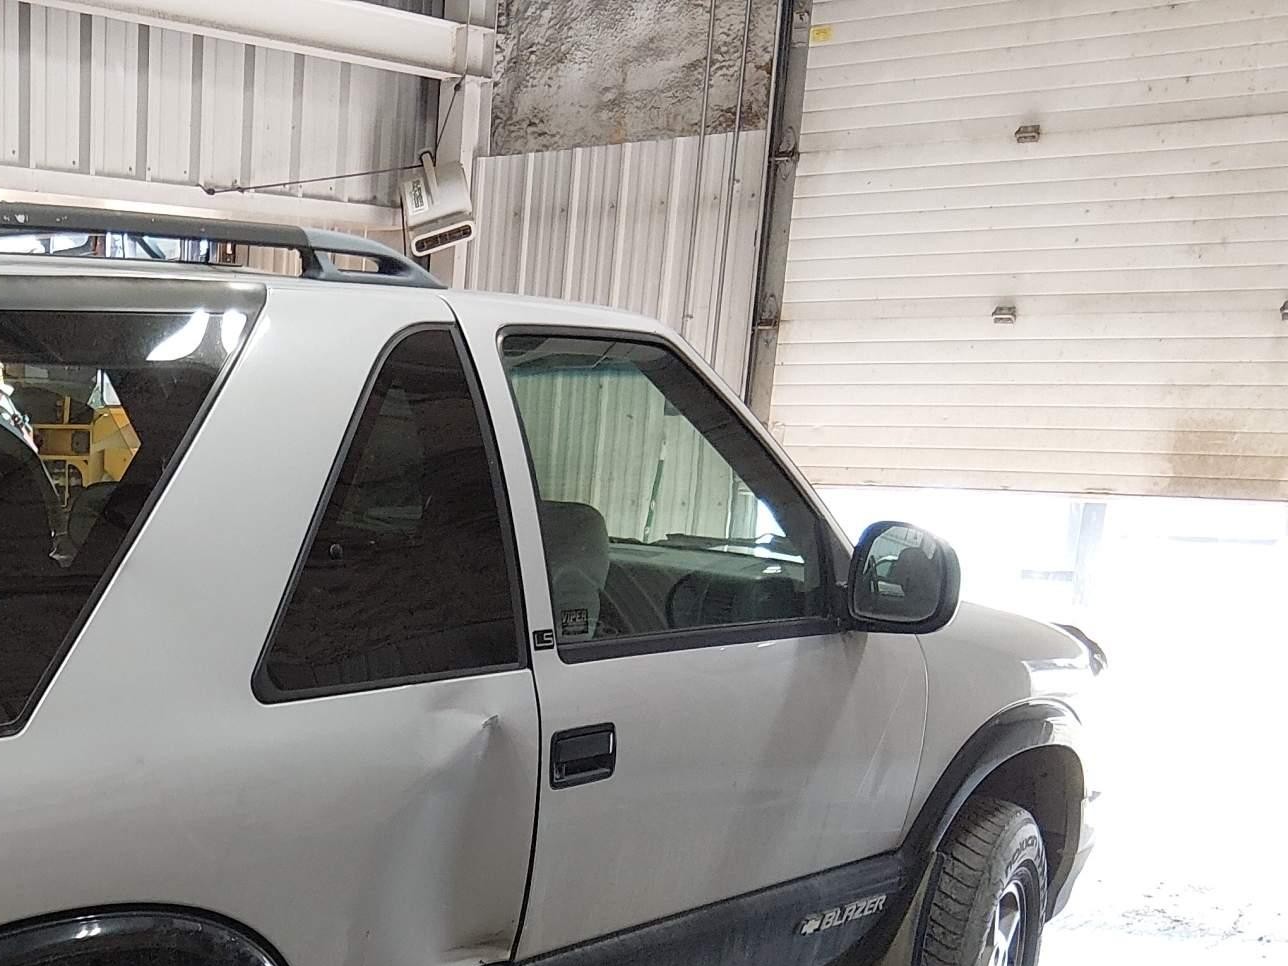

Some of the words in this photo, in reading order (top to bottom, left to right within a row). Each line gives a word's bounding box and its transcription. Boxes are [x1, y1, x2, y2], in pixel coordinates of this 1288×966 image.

[561, 609, 588, 624] VIPER
[534, 632, 554, 647] LS
[820, 894, 888, 931] BLAZER
